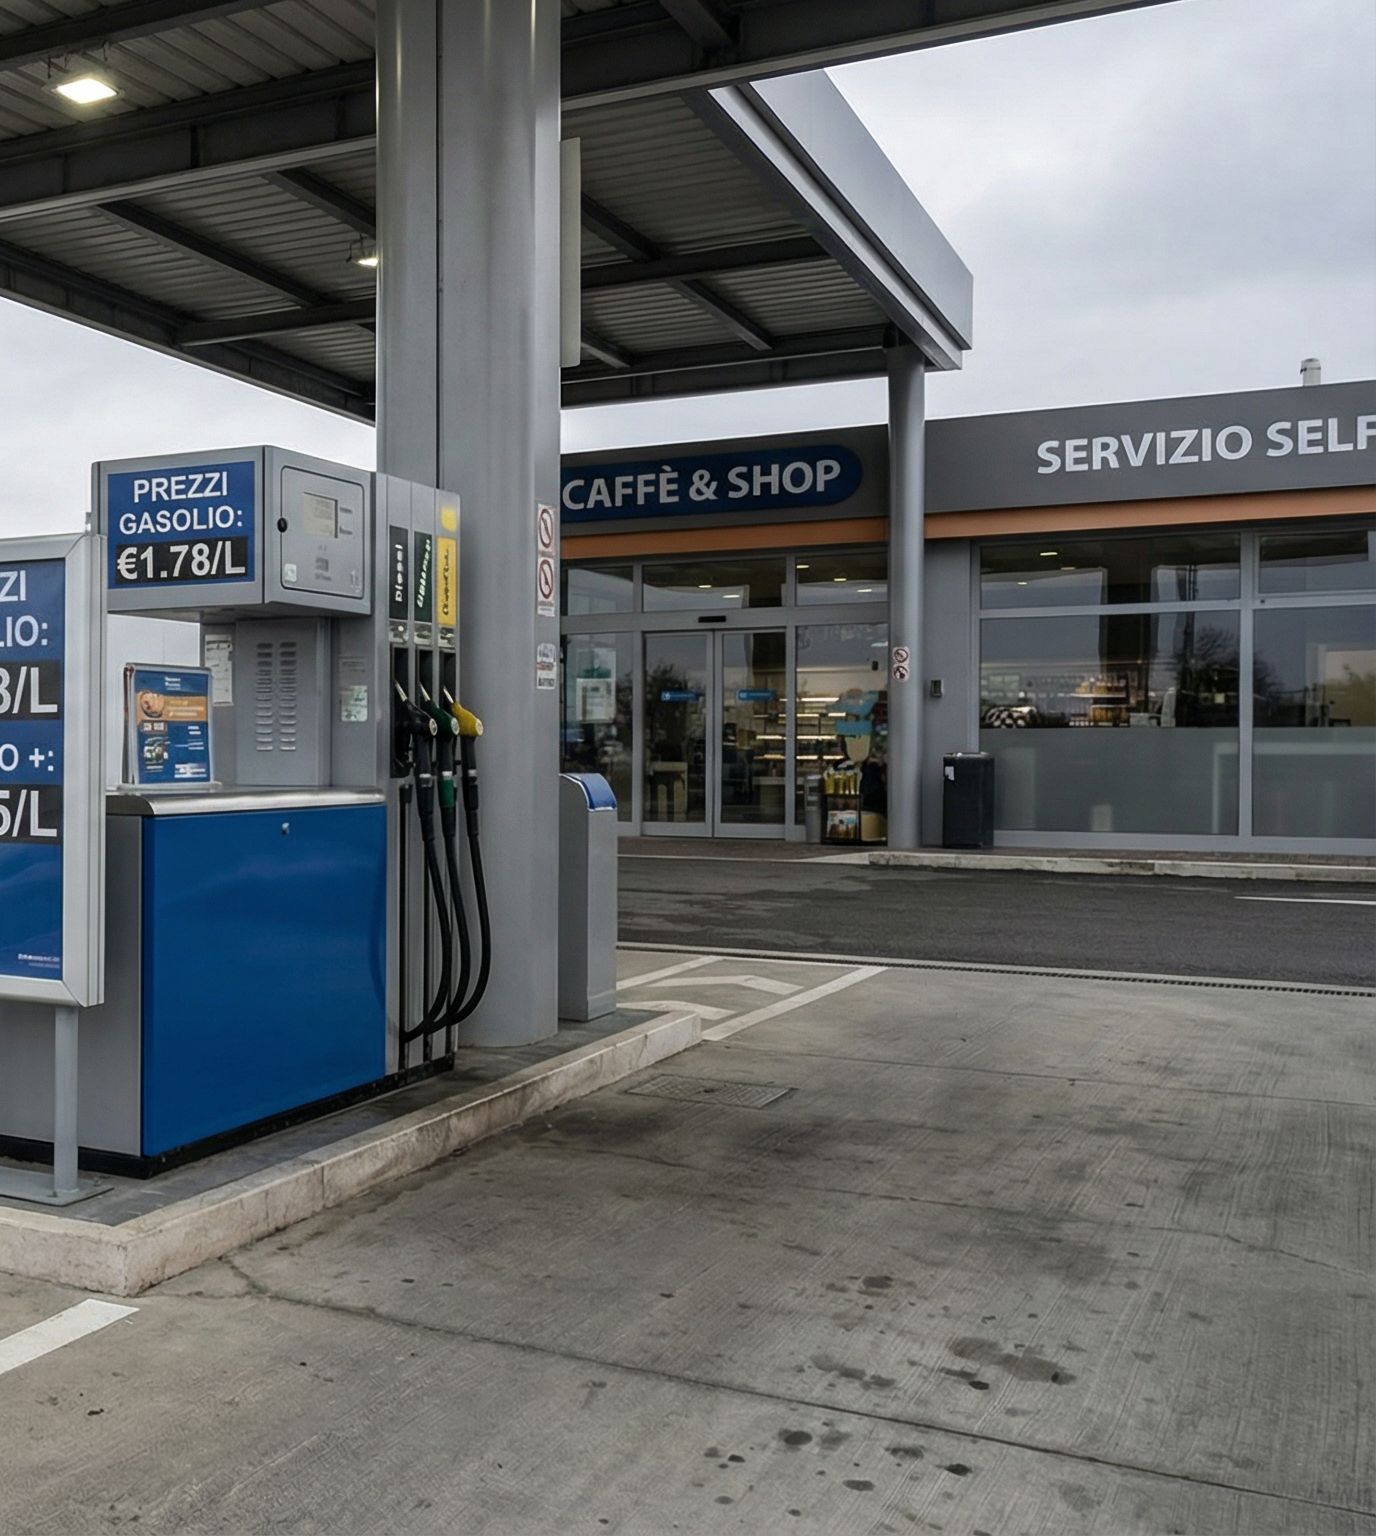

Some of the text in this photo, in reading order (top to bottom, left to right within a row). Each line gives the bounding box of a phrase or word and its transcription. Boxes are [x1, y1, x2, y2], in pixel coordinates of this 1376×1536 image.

[1037, 414, 1376, 474] SERVIZIO SELF
[134, 471, 228, 503] PREZZI
[562, 459, 841, 510] CAFFÈ & SHOP
[119, 505, 242, 535] GASOLIO:
[117, 541, 246, 580] €1.78/L
[28, 748, 54, 772] +:
